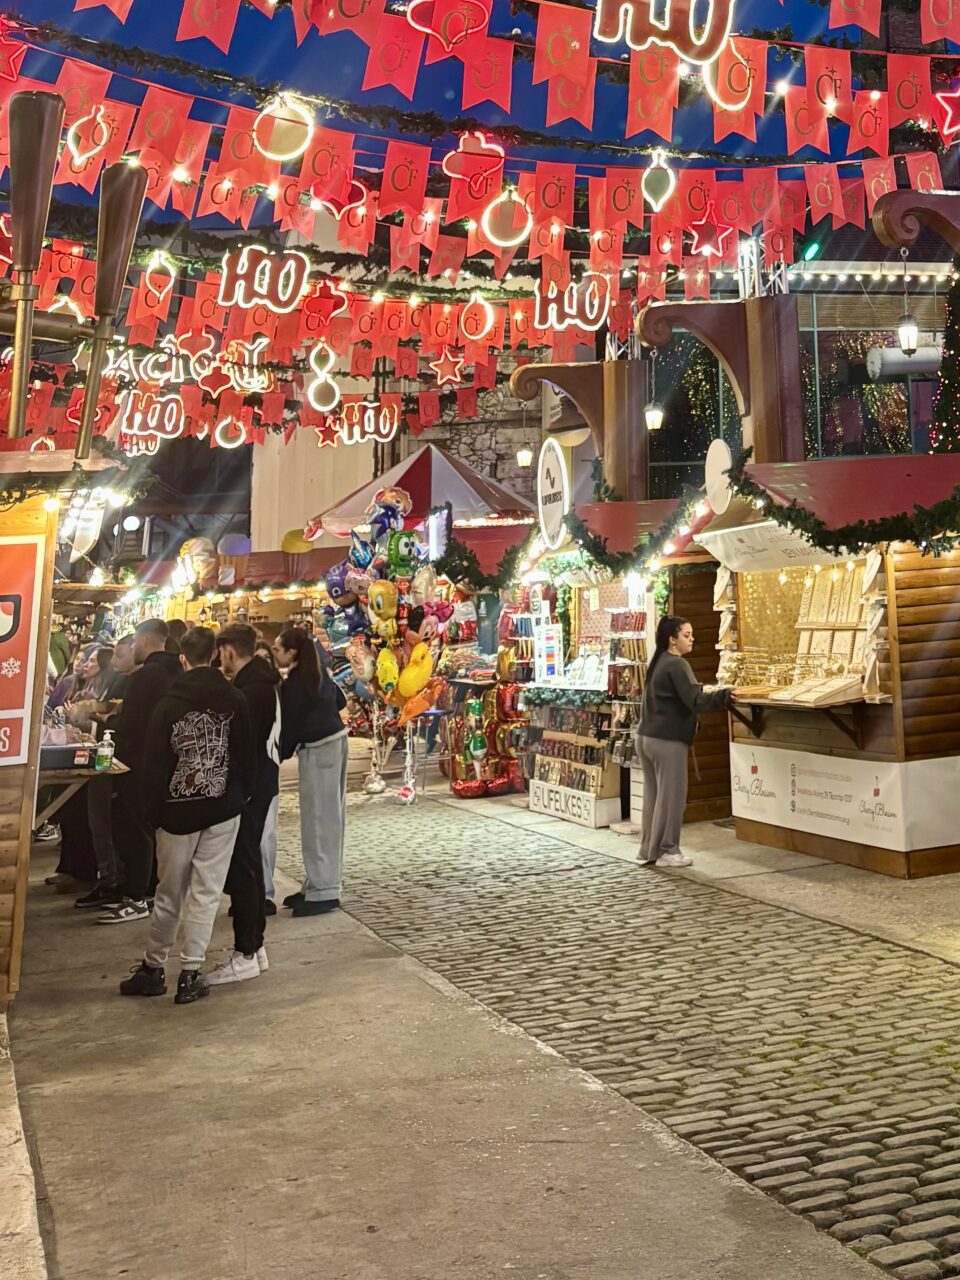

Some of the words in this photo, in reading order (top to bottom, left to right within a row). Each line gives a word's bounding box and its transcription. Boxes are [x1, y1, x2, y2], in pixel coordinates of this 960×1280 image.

[816, 74, 842, 106] CF
[896, 79, 922, 110] CF
[858, 110, 881, 138] CF
[312, 148, 340, 177] CF
[391, 164, 418, 192] CF
[467, 173, 494, 200] CF
[542, 182, 567, 208] CF
[613, 185, 635, 212] CF
[218, 245, 311, 314] HO
[534, 271, 611, 332] HO
[120, 389, 185, 439] HO
[340, 401, 399, 445] HO
[540, 789, 583, 819] LIFELIKES
